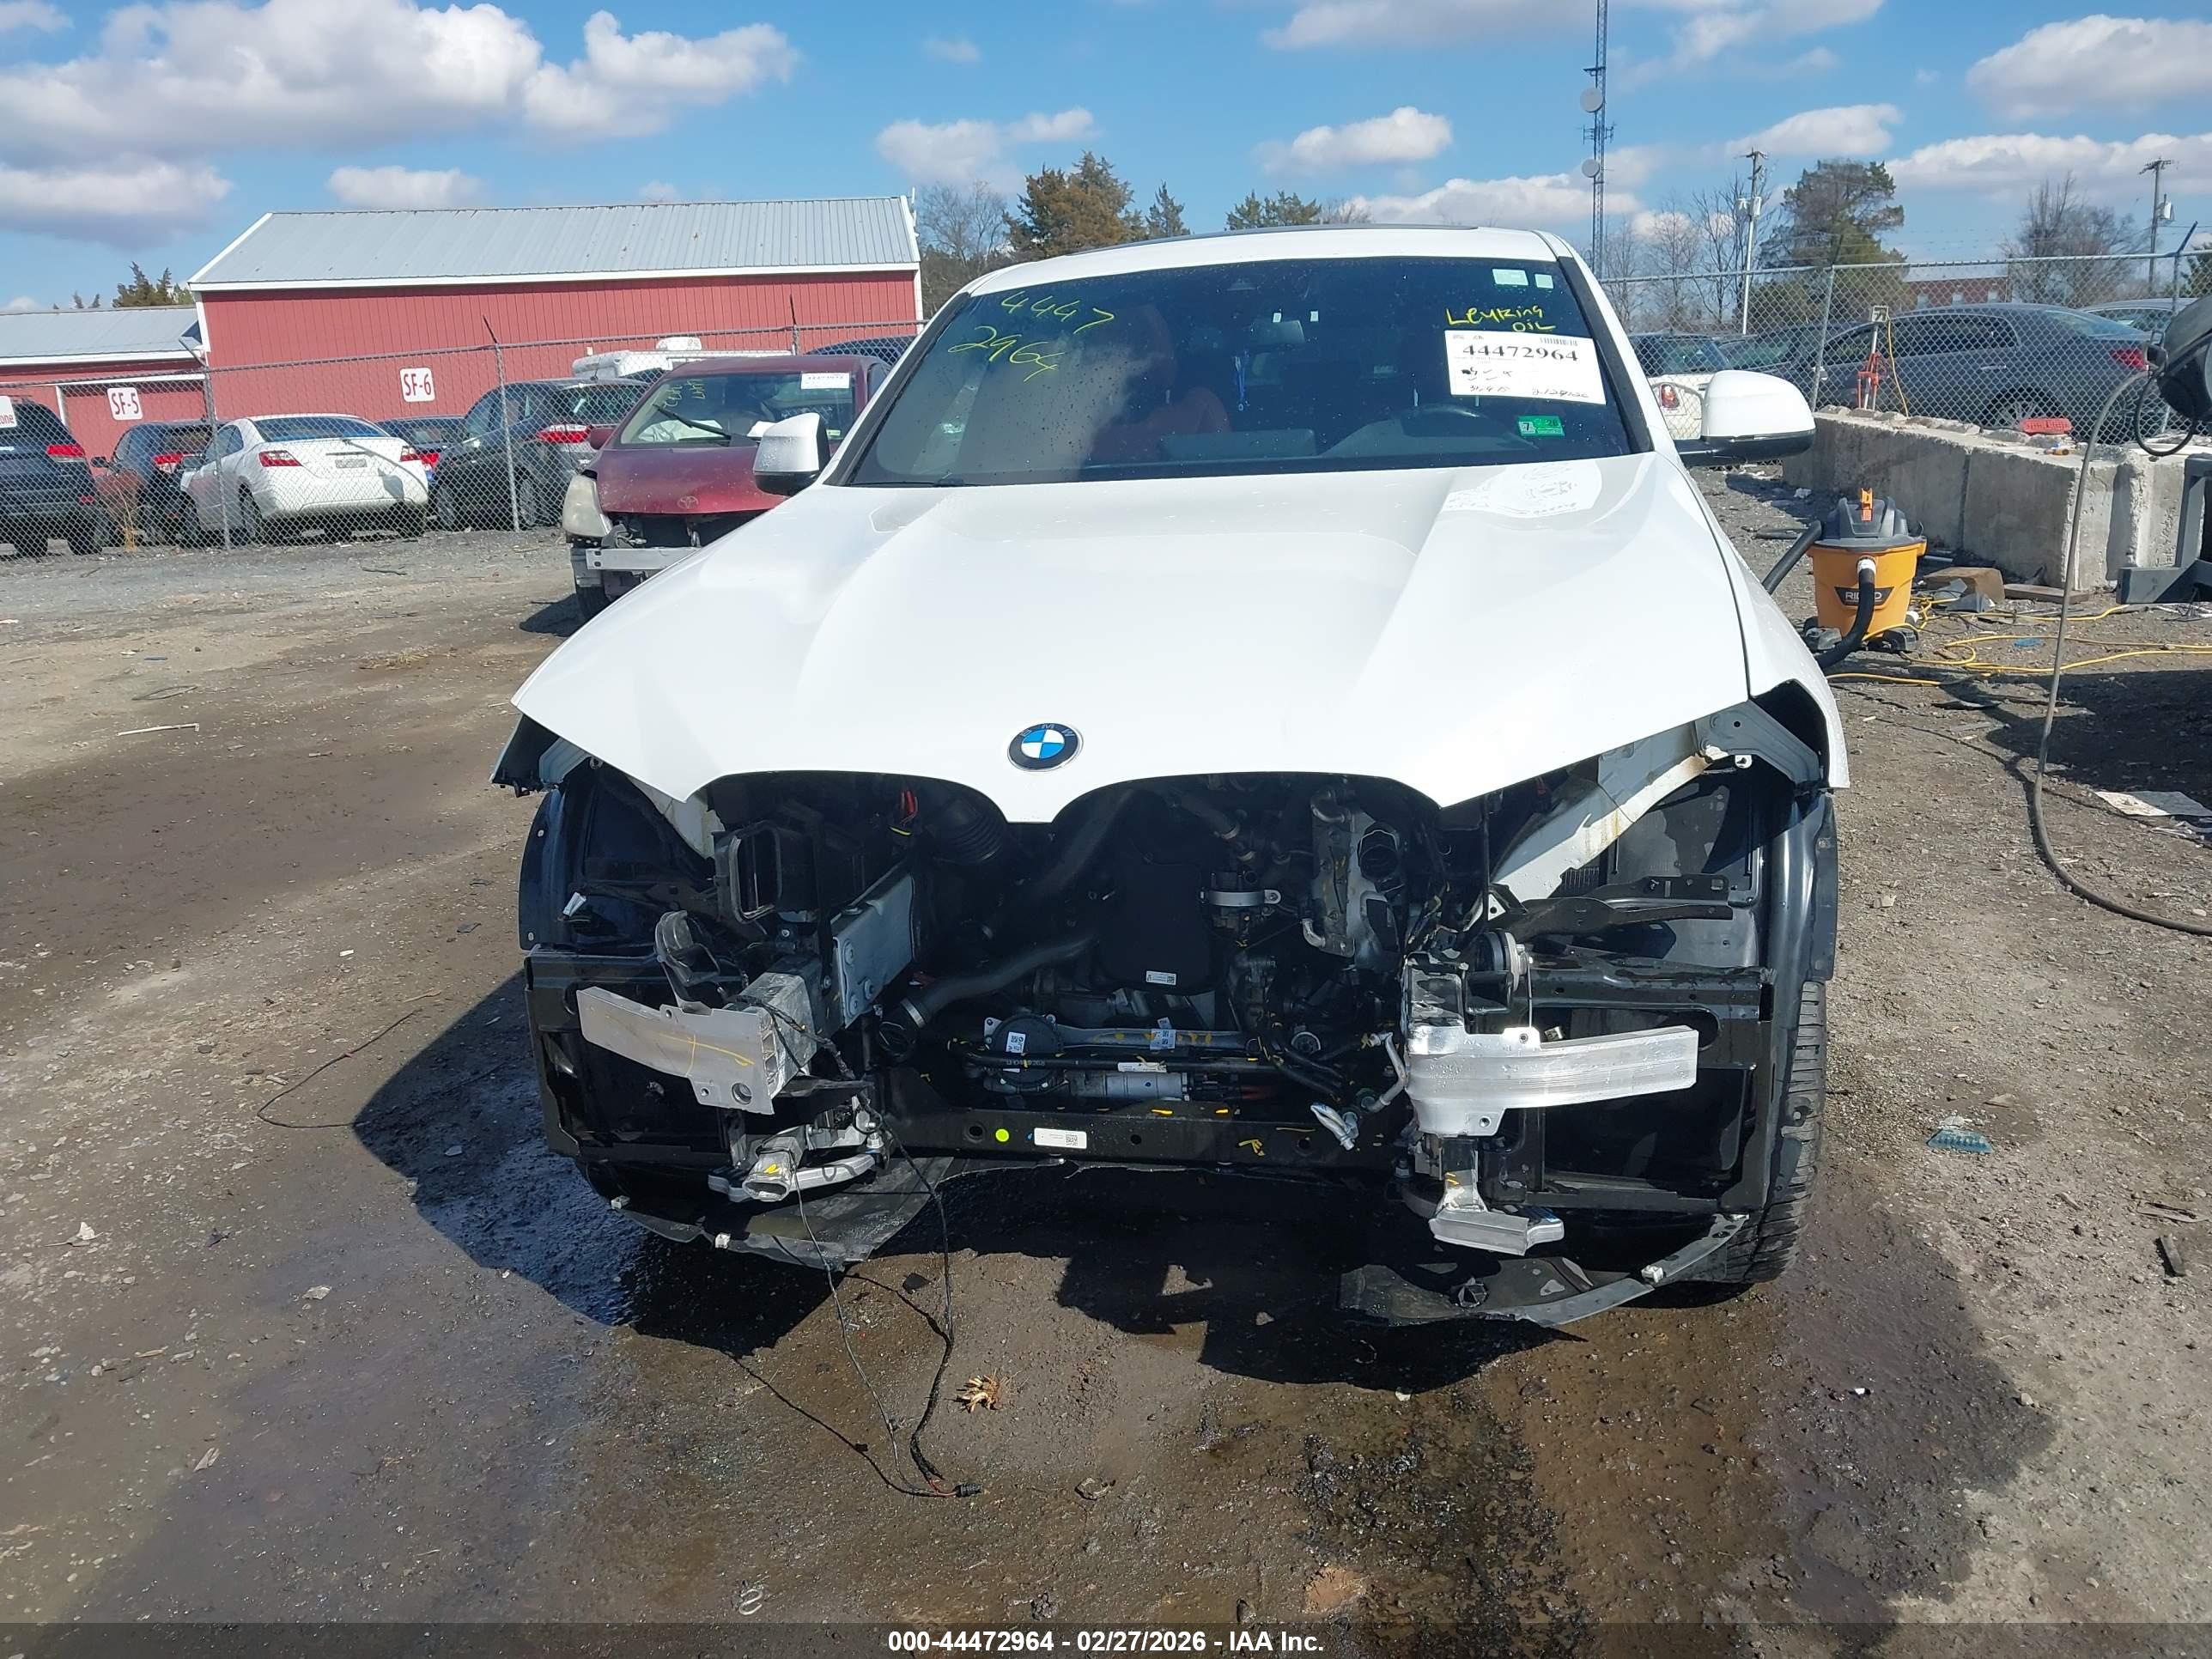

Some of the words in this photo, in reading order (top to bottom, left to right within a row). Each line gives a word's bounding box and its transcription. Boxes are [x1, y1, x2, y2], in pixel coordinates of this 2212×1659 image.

[1001, 290, 1115, 334] 4447
[948, 325, 1065, 382] 2964
[1462, 344, 1579, 362] 44472964
[404, 374, 431, 396] SF-6
[111, 392, 139, 416] SF-5
